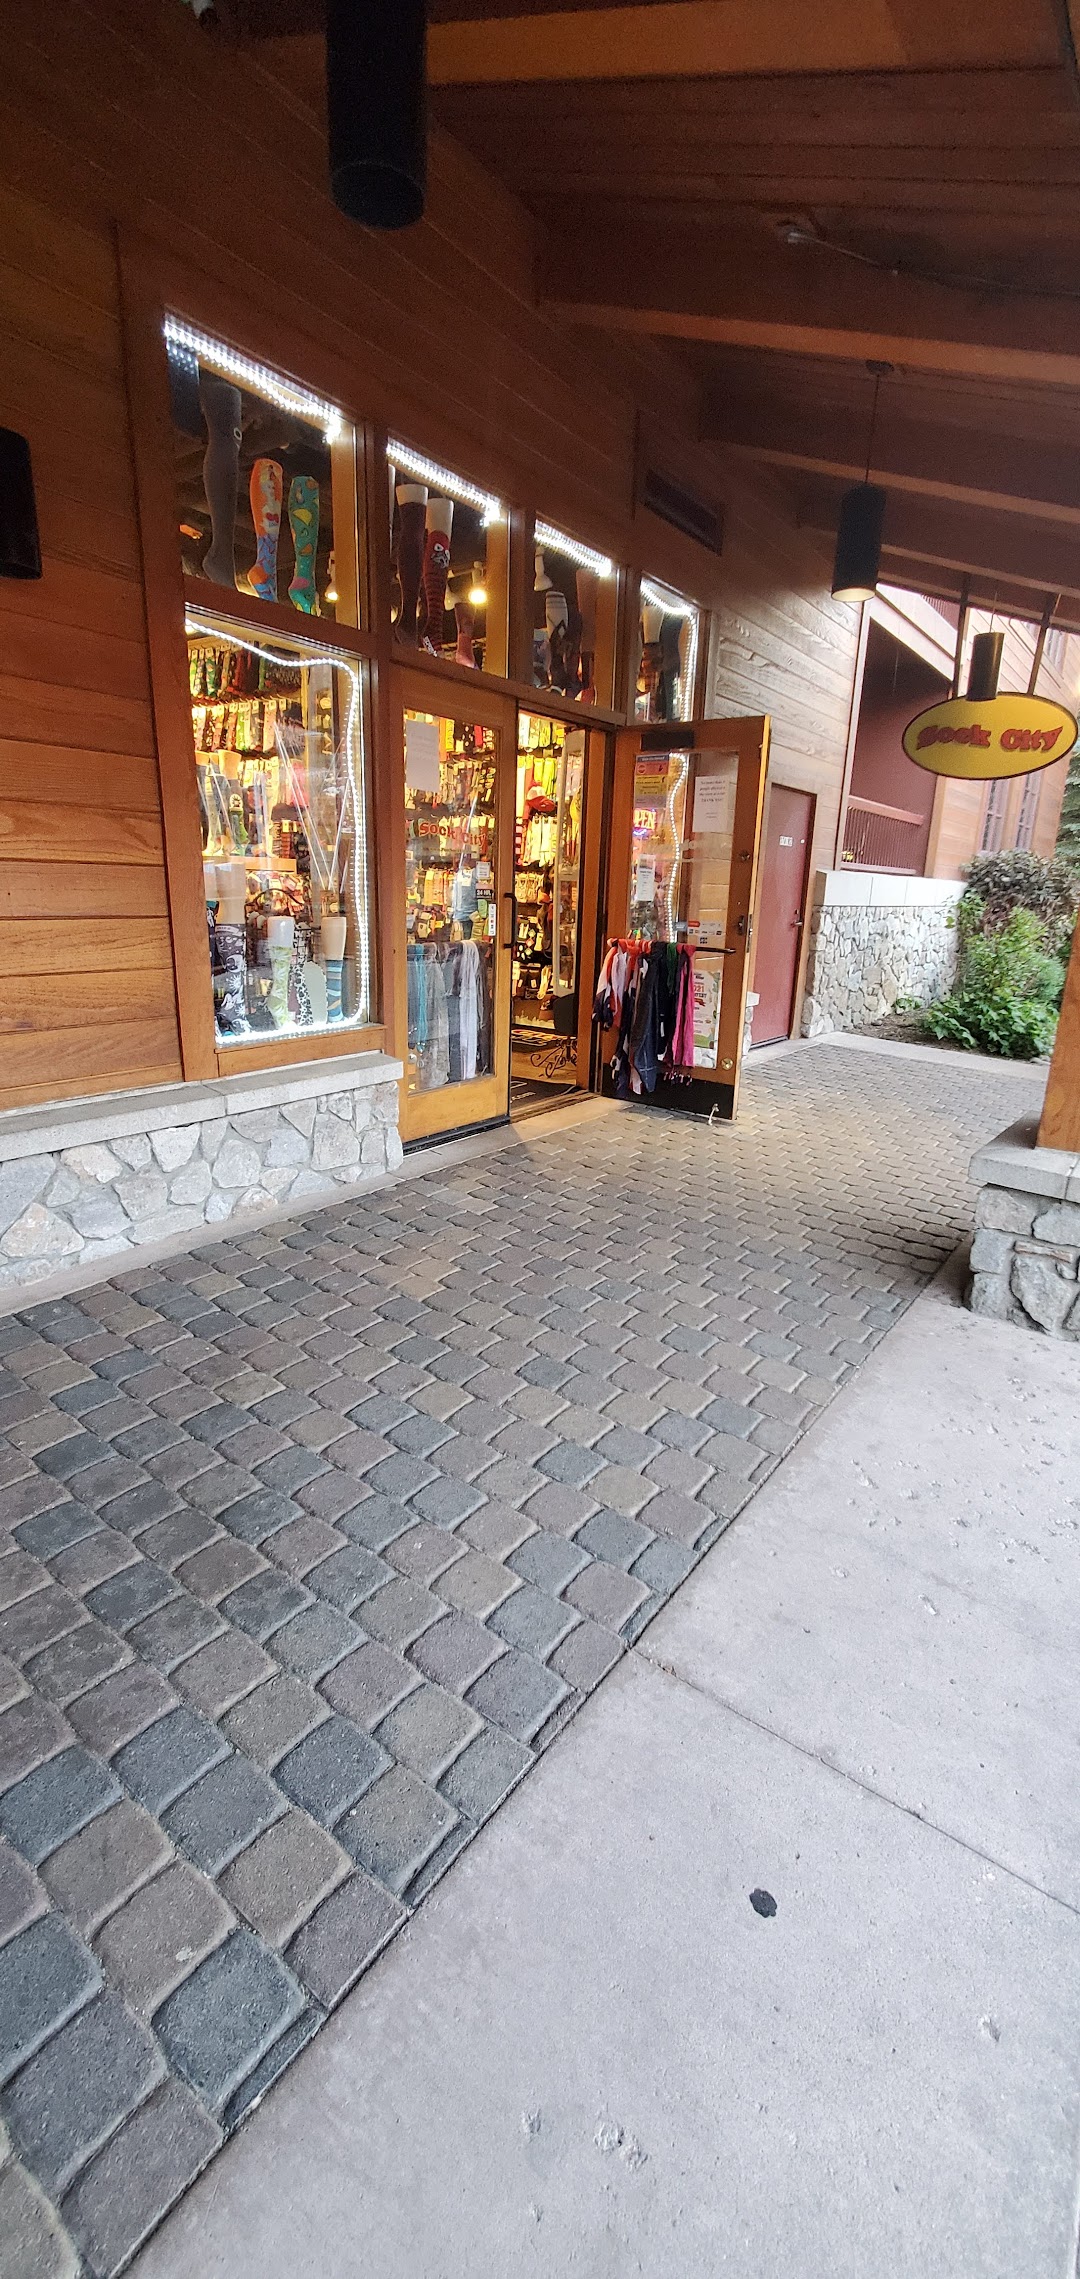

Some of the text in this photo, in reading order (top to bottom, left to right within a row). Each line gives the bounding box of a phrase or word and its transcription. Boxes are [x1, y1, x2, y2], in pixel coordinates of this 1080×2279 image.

[916, 724, 992, 750] Sock
[419, 822, 486, 847] Sock City
